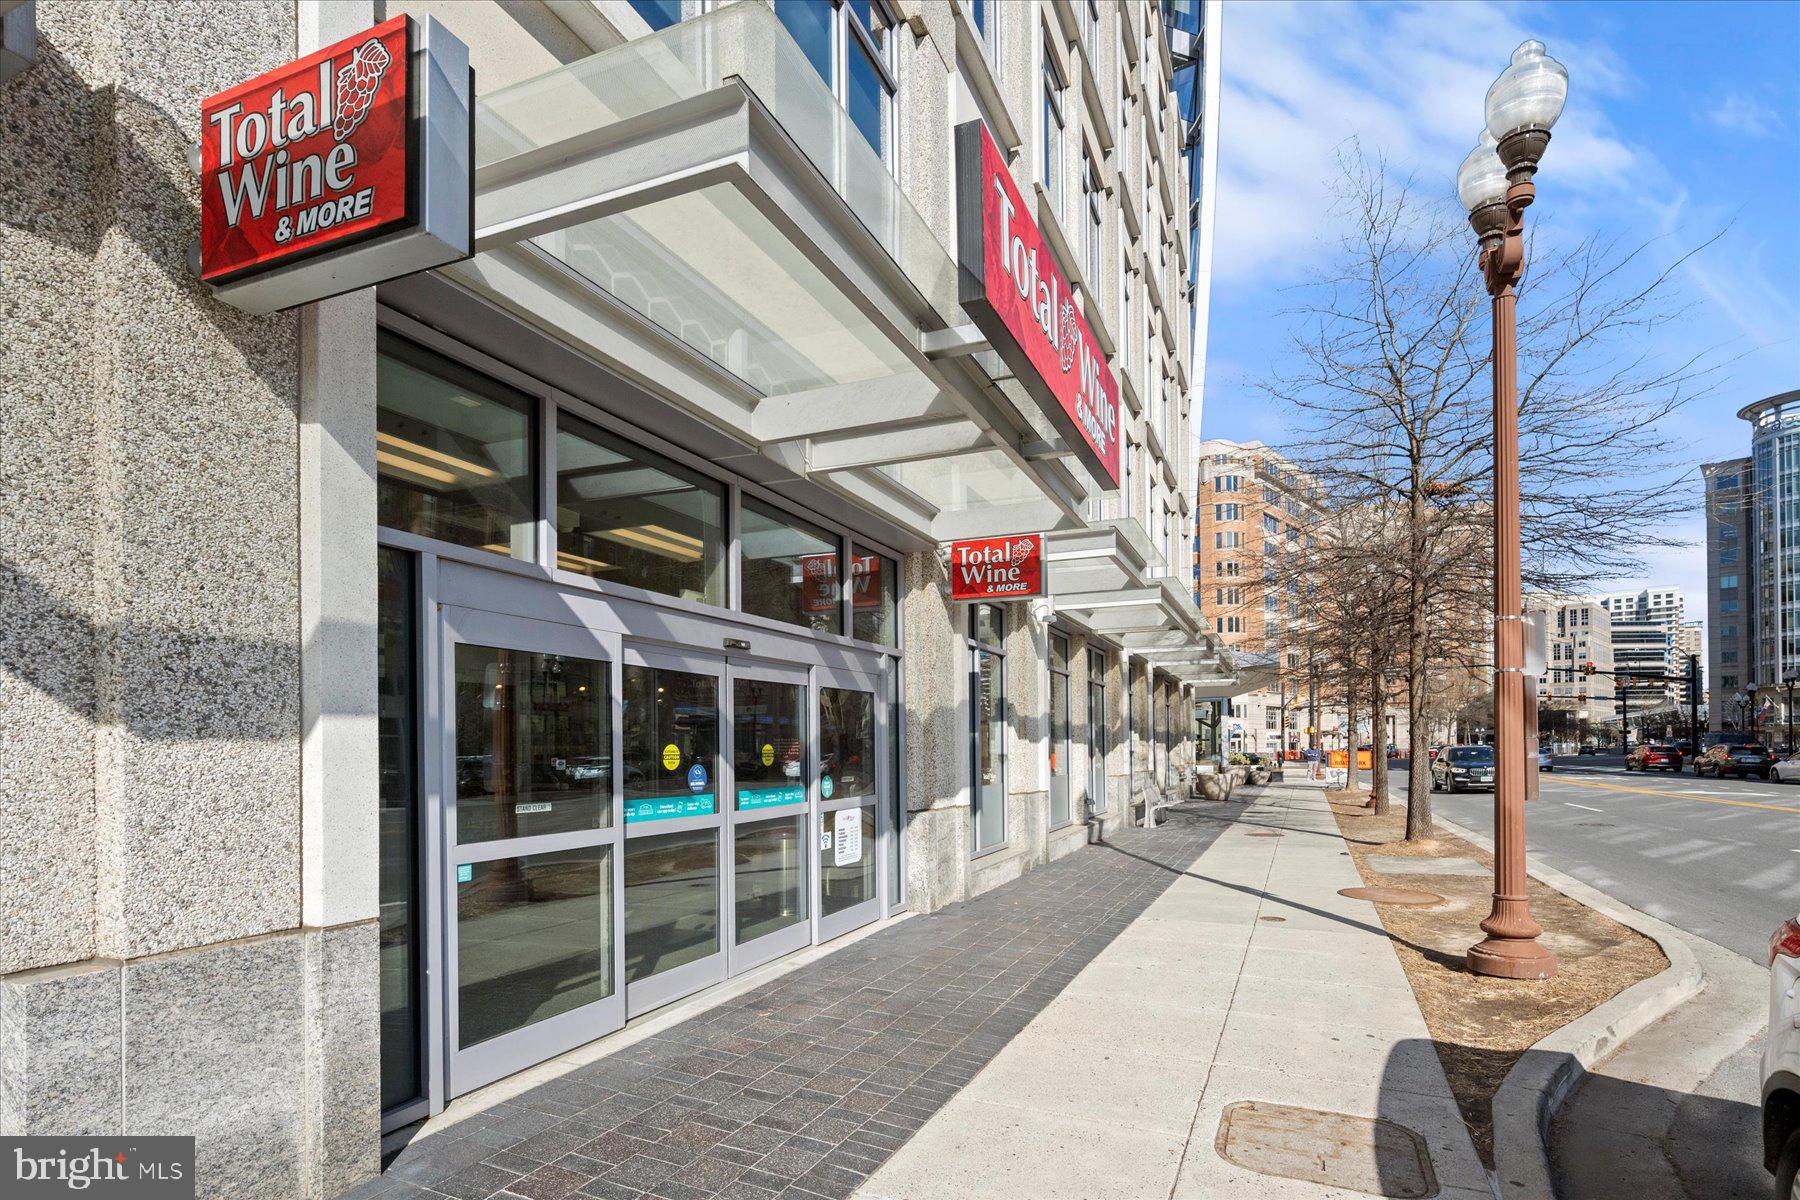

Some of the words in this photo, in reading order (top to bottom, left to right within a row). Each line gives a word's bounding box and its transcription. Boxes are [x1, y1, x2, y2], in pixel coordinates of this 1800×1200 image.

[210, 59, 334, 168] Total
[217, 141, 357, 228] Wine
[274, 216, 292, 243] &
[296, 186, 375, 236] MORE
[994, 174, 1059, 352] Total
[1077, 327, 1116, 445] Wine
[1076, 392, 1083, 420] &
[1083, 401, 1106, 456] MORE
[957, 541, 1011, 565] Total
[960, 563, 1021, 585] Wine
[986, 585, 994, 593] &
[996, 582, 1027, 592] MORE
